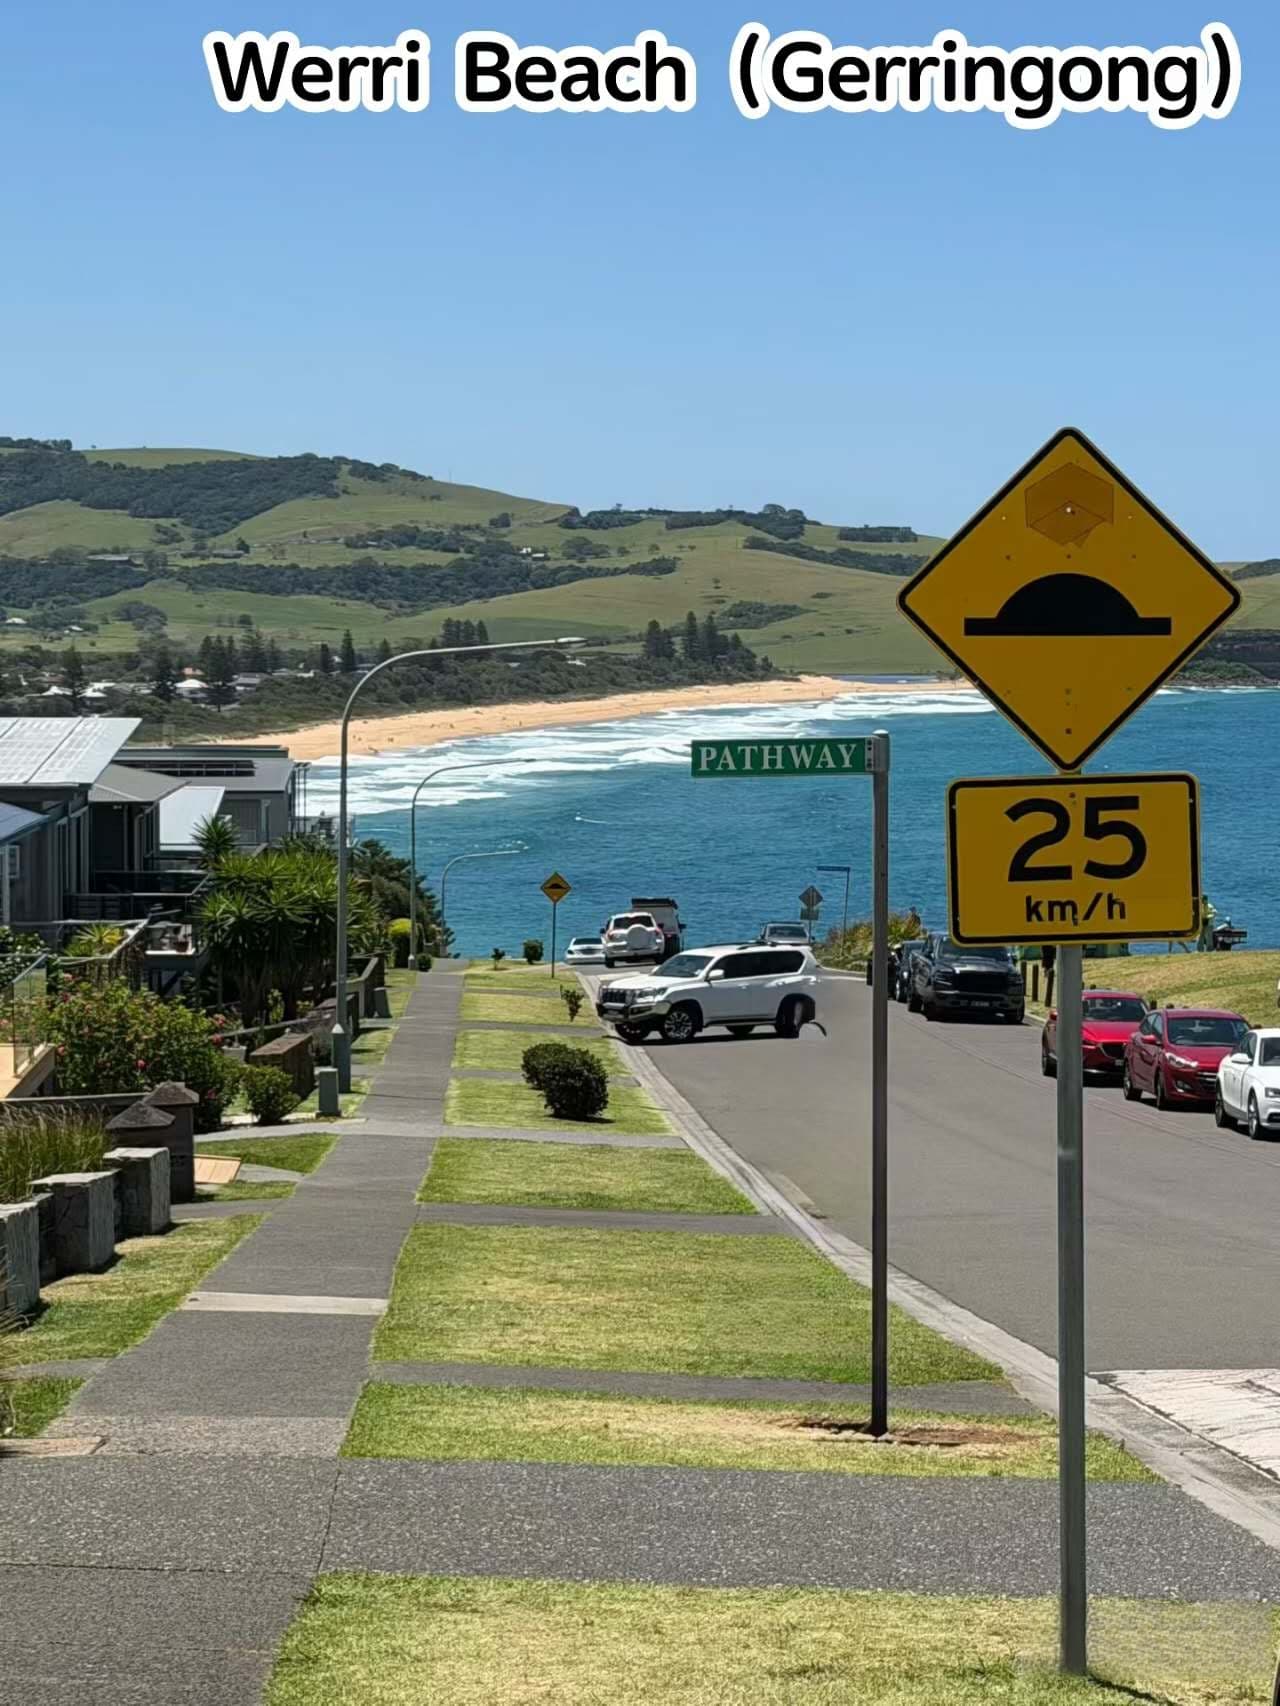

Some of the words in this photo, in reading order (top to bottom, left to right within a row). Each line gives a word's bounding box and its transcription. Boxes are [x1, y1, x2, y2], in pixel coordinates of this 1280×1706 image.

[699, 743, 857, 771] PATHWAY
[1004, 794, 1147, 882] 25
[1025, 892, 1127, 925] km/h
